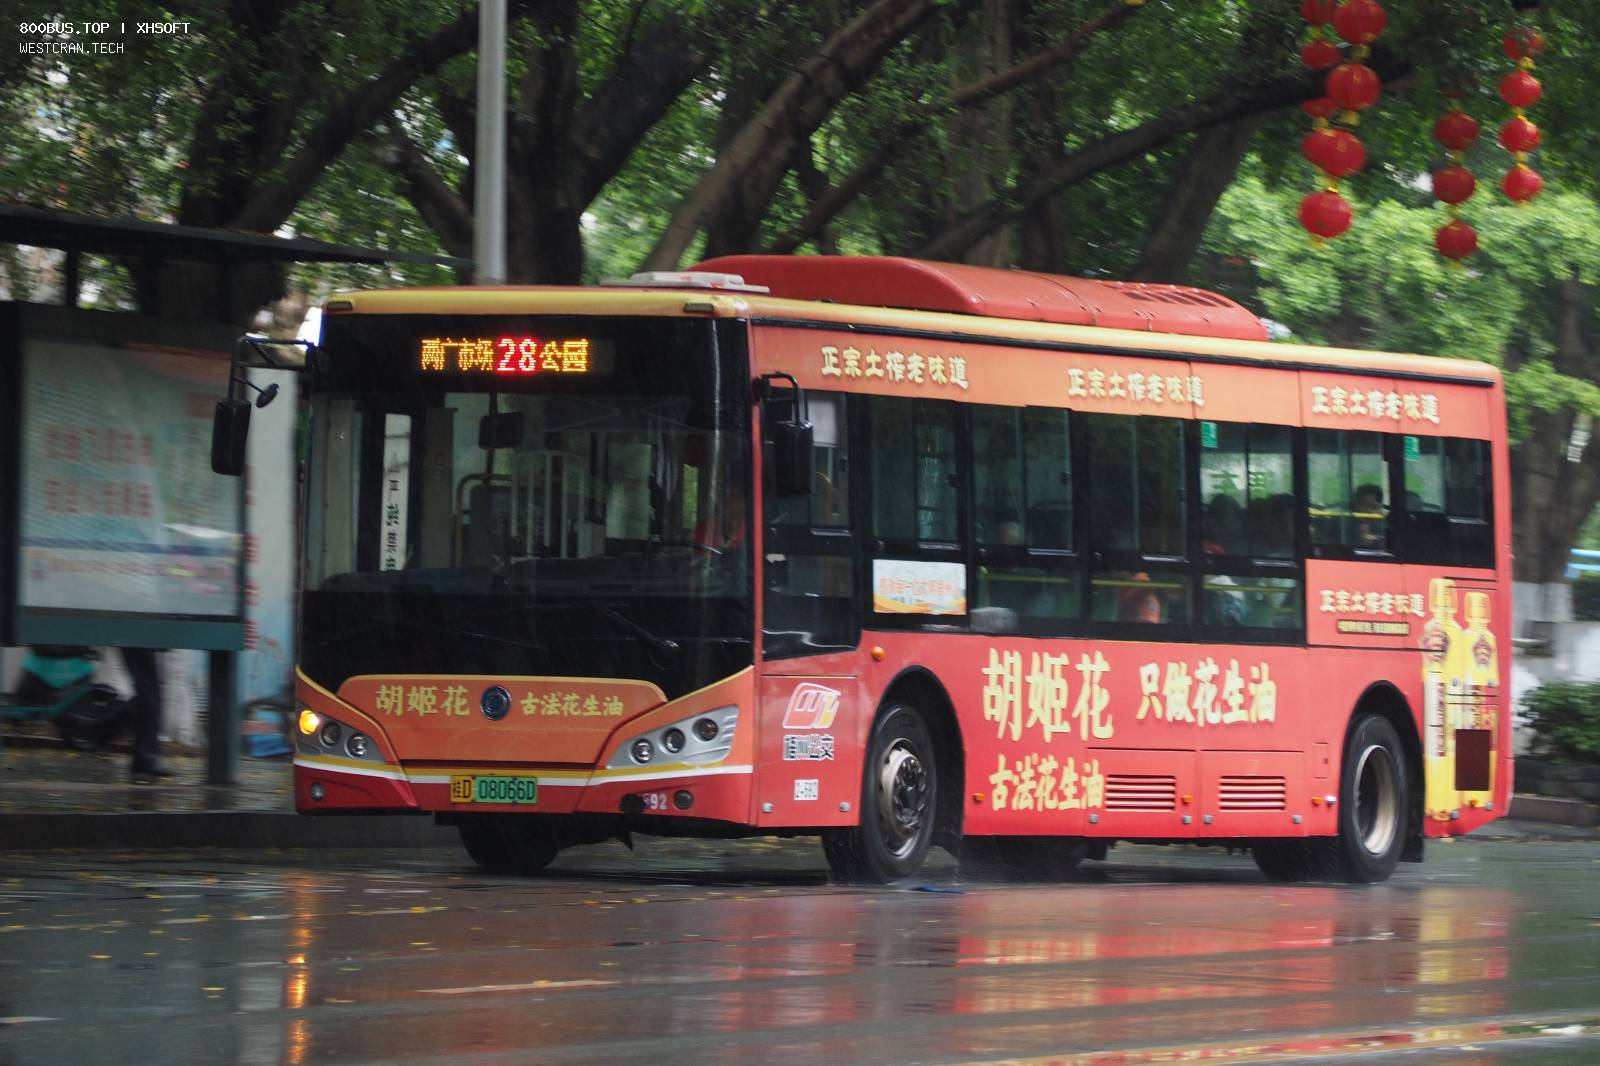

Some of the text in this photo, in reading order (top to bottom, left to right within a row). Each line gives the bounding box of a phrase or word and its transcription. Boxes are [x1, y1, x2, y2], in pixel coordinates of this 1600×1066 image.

[497, 337, 537, 371] 28
[820, 345, 969, 390] 正宗土榨老味道
[1067, 367, 1206, 407] 正宗土榨老味道
[375, 684, 471, 717] 胡姬花
[519, 691, 625, 718] 古法花生油
[981, 647, 1115, 743] 胡姬花
[1136, 656, 1278, 728] 只做花生油
[988, 752, 1105, 813] 古法花生油
